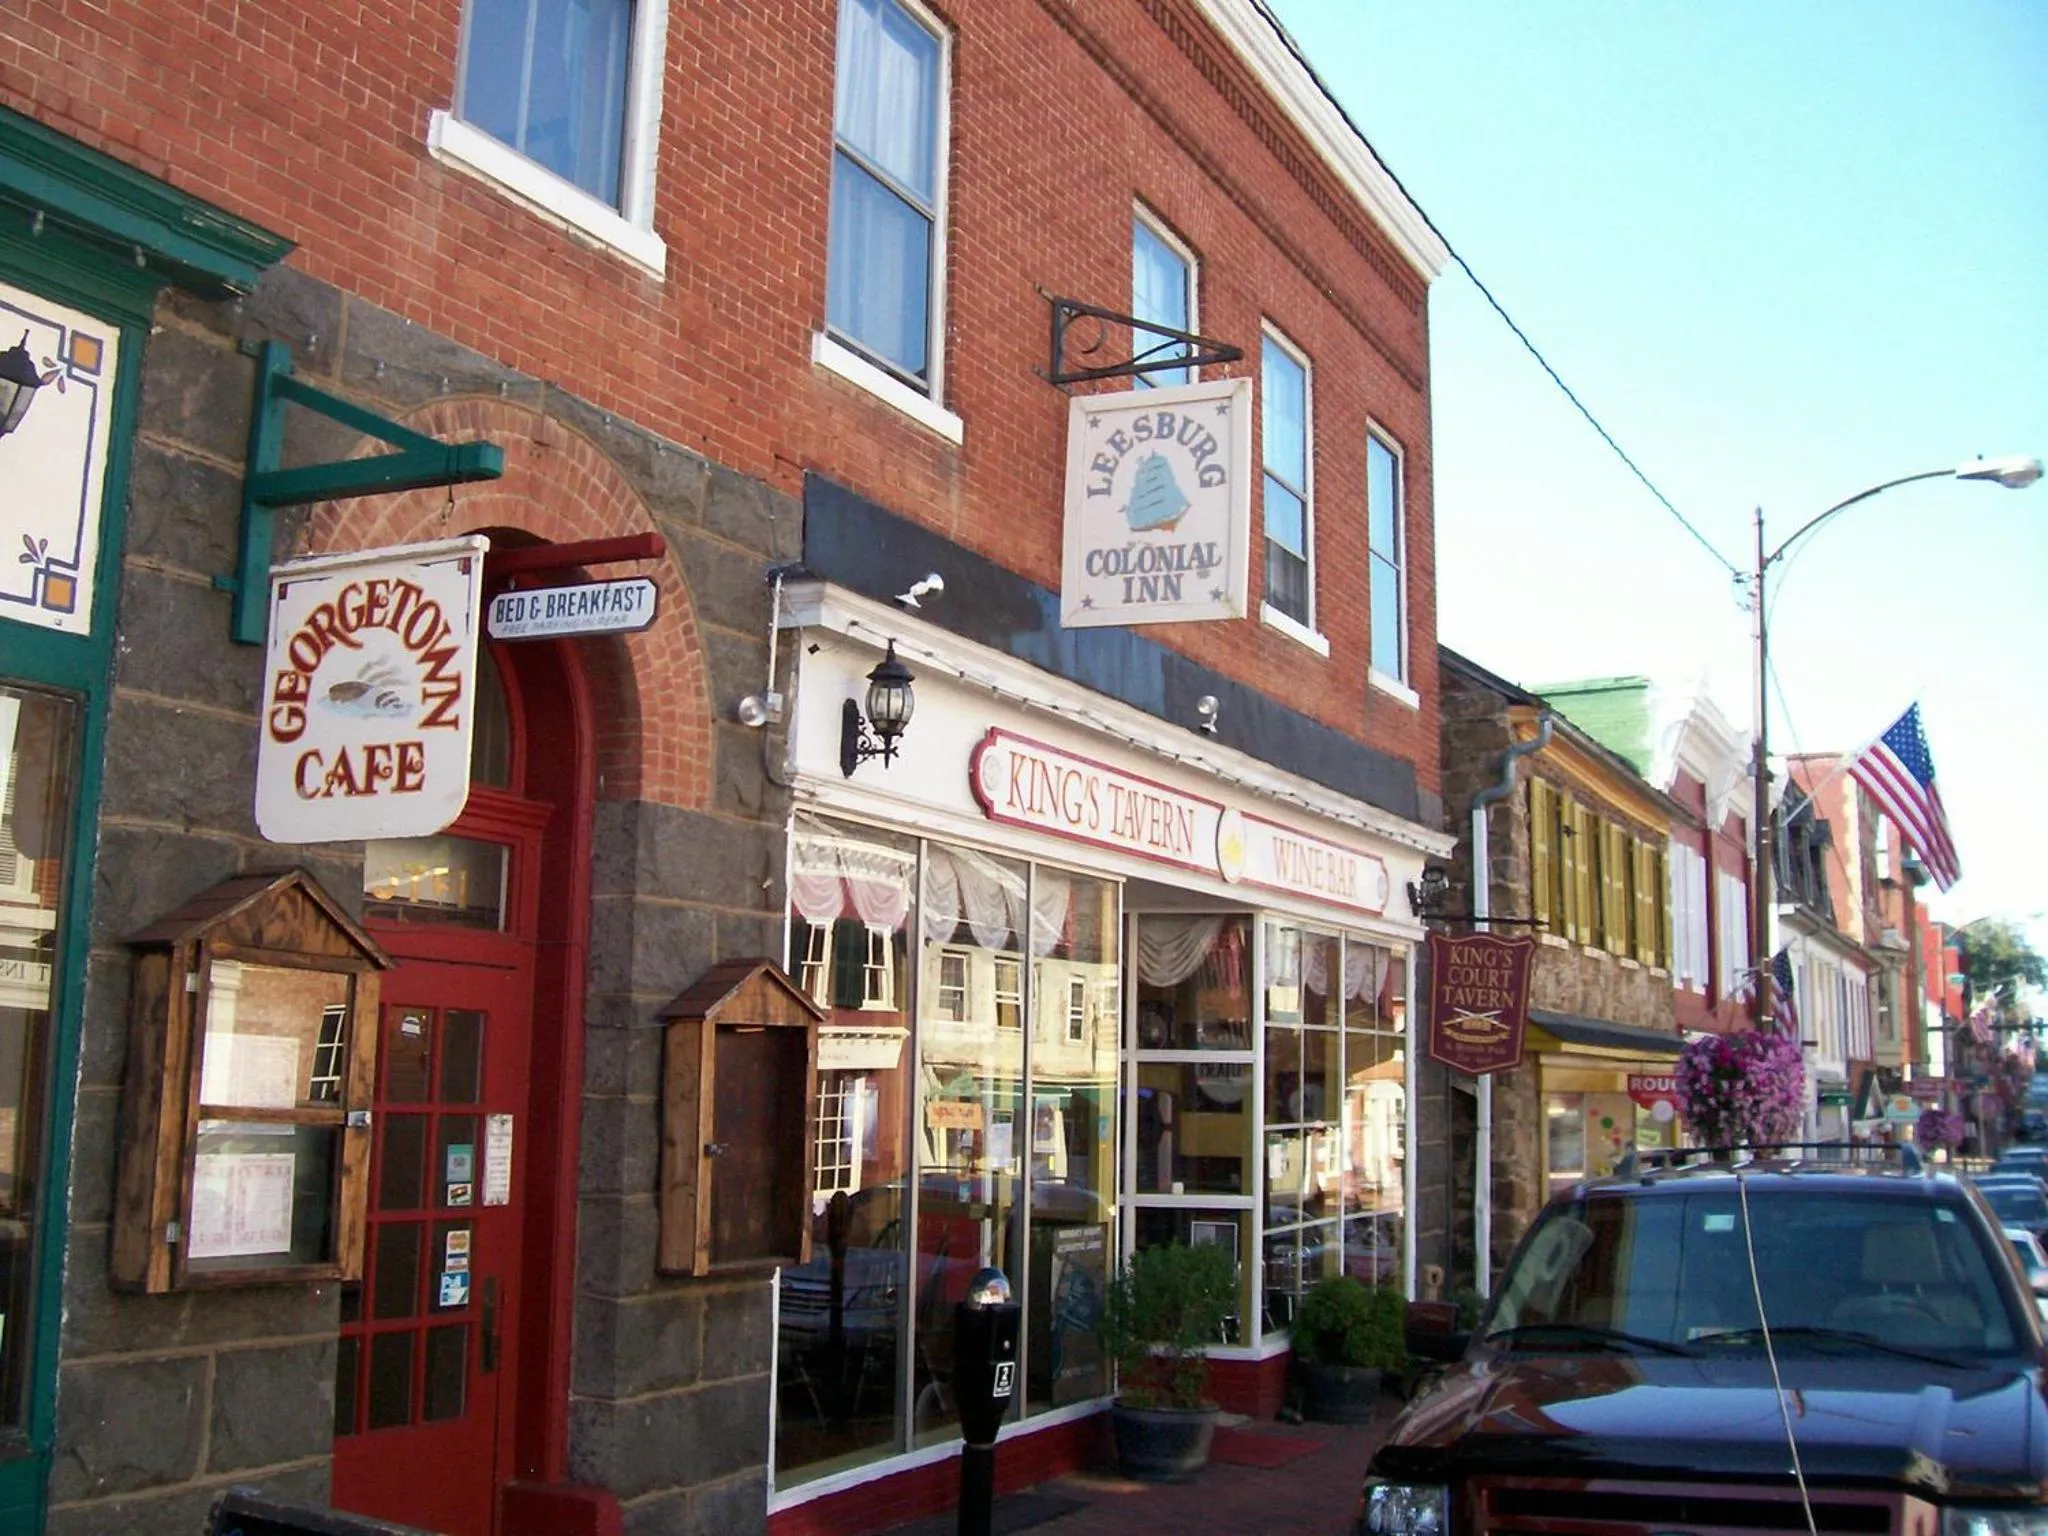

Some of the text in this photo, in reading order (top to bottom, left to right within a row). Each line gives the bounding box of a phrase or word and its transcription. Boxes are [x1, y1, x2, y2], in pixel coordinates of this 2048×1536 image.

[1087, 412, 1226, 499] LEESBURG
[1086, 542, 1222, 577] COLONIAL
[495, 586, 647, 623] BED & BREAKFAST
[1122, 573, 1184, 604] INN
[269, 578, 461, 743] GEORGETOWN
[295, 741, 426, 800] CAFE
[1006, 750, 1195, 855] KING'S TAVERN
[1273, 836, 1356, 897] WINE BAR
[1450, 945, 1513, 967] KING'S
[1448, 967, 1513, 988] COURT
[1442, 985, 1515, 1009] TAVERN
